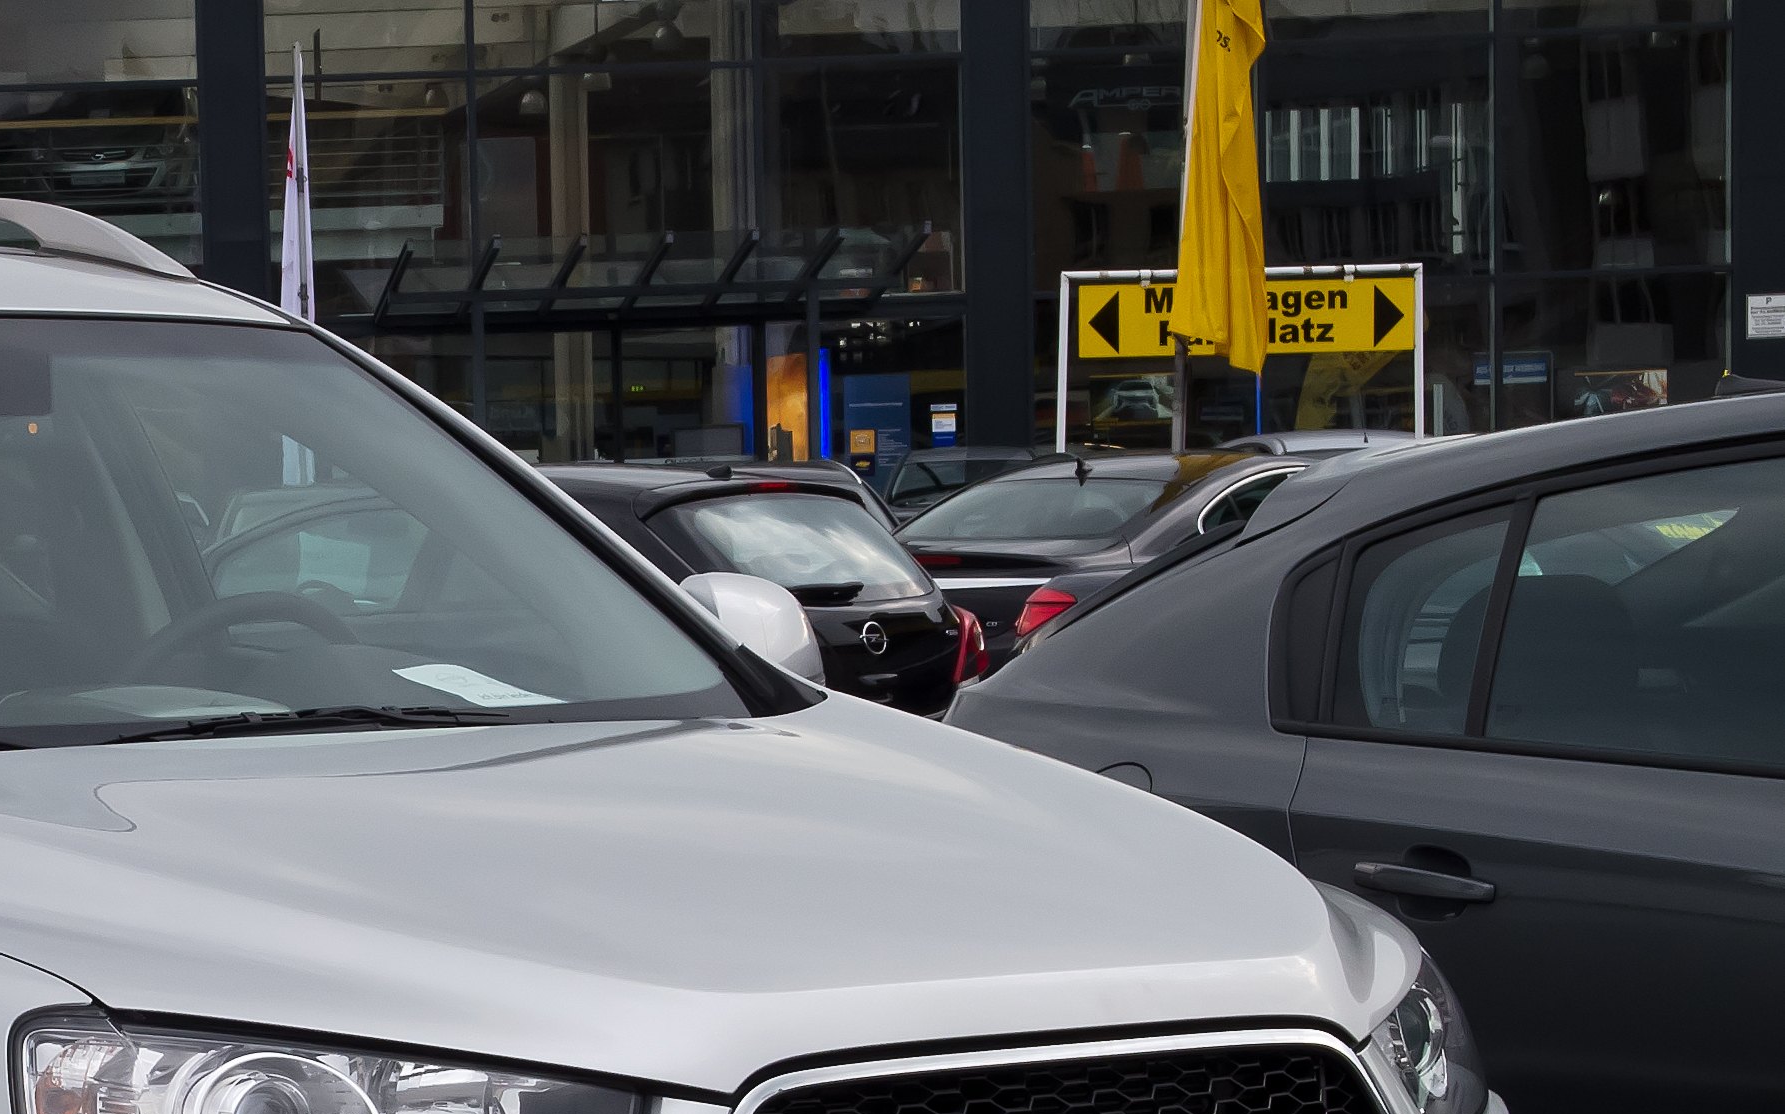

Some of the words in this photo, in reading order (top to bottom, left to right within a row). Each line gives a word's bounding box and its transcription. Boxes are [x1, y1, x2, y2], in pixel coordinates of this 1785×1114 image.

[1069, 86, 1182, 108] AMPER
[1144, 287, 1348, 318] Magen
[1158, 317, 1335, 347] Platz
